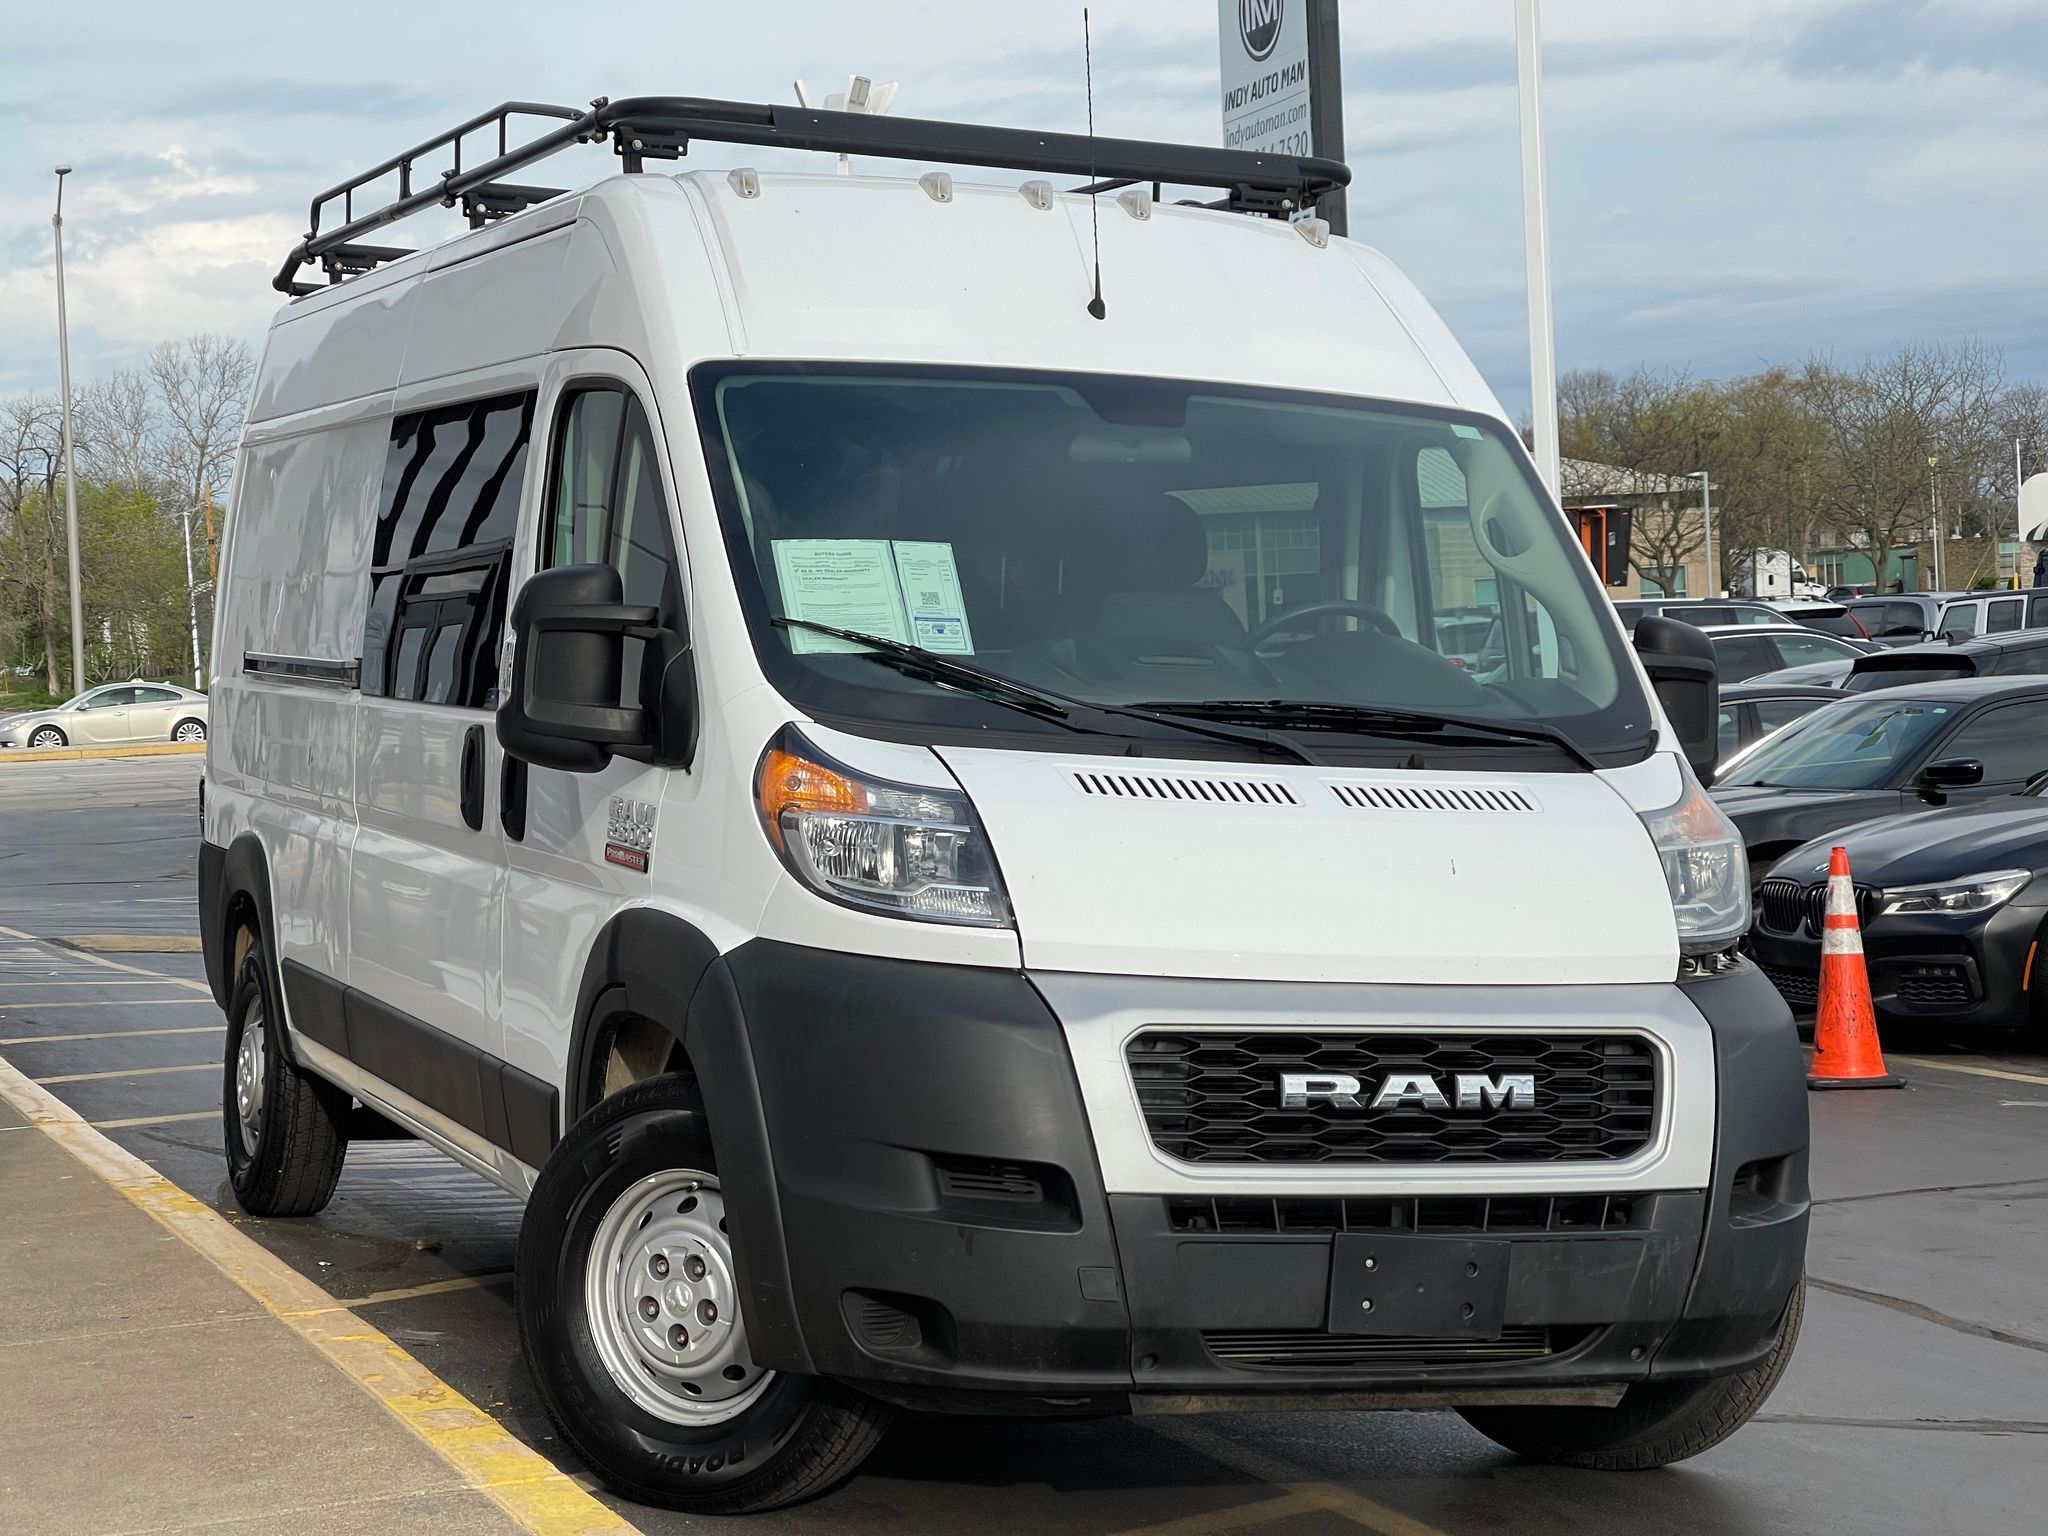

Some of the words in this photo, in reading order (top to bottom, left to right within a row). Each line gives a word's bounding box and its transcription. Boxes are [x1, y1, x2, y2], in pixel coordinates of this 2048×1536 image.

[1224, 83, 1249, 113] INDY
[1250, 71, 1278, 100] AUTO
[1281, 59, 1305, 90] MAN
[1225, 102, 1307, 149] indyautoman.com
[608, 796, 657, 828] RAM
[1280, 1073, 1535, 1110] RAM
